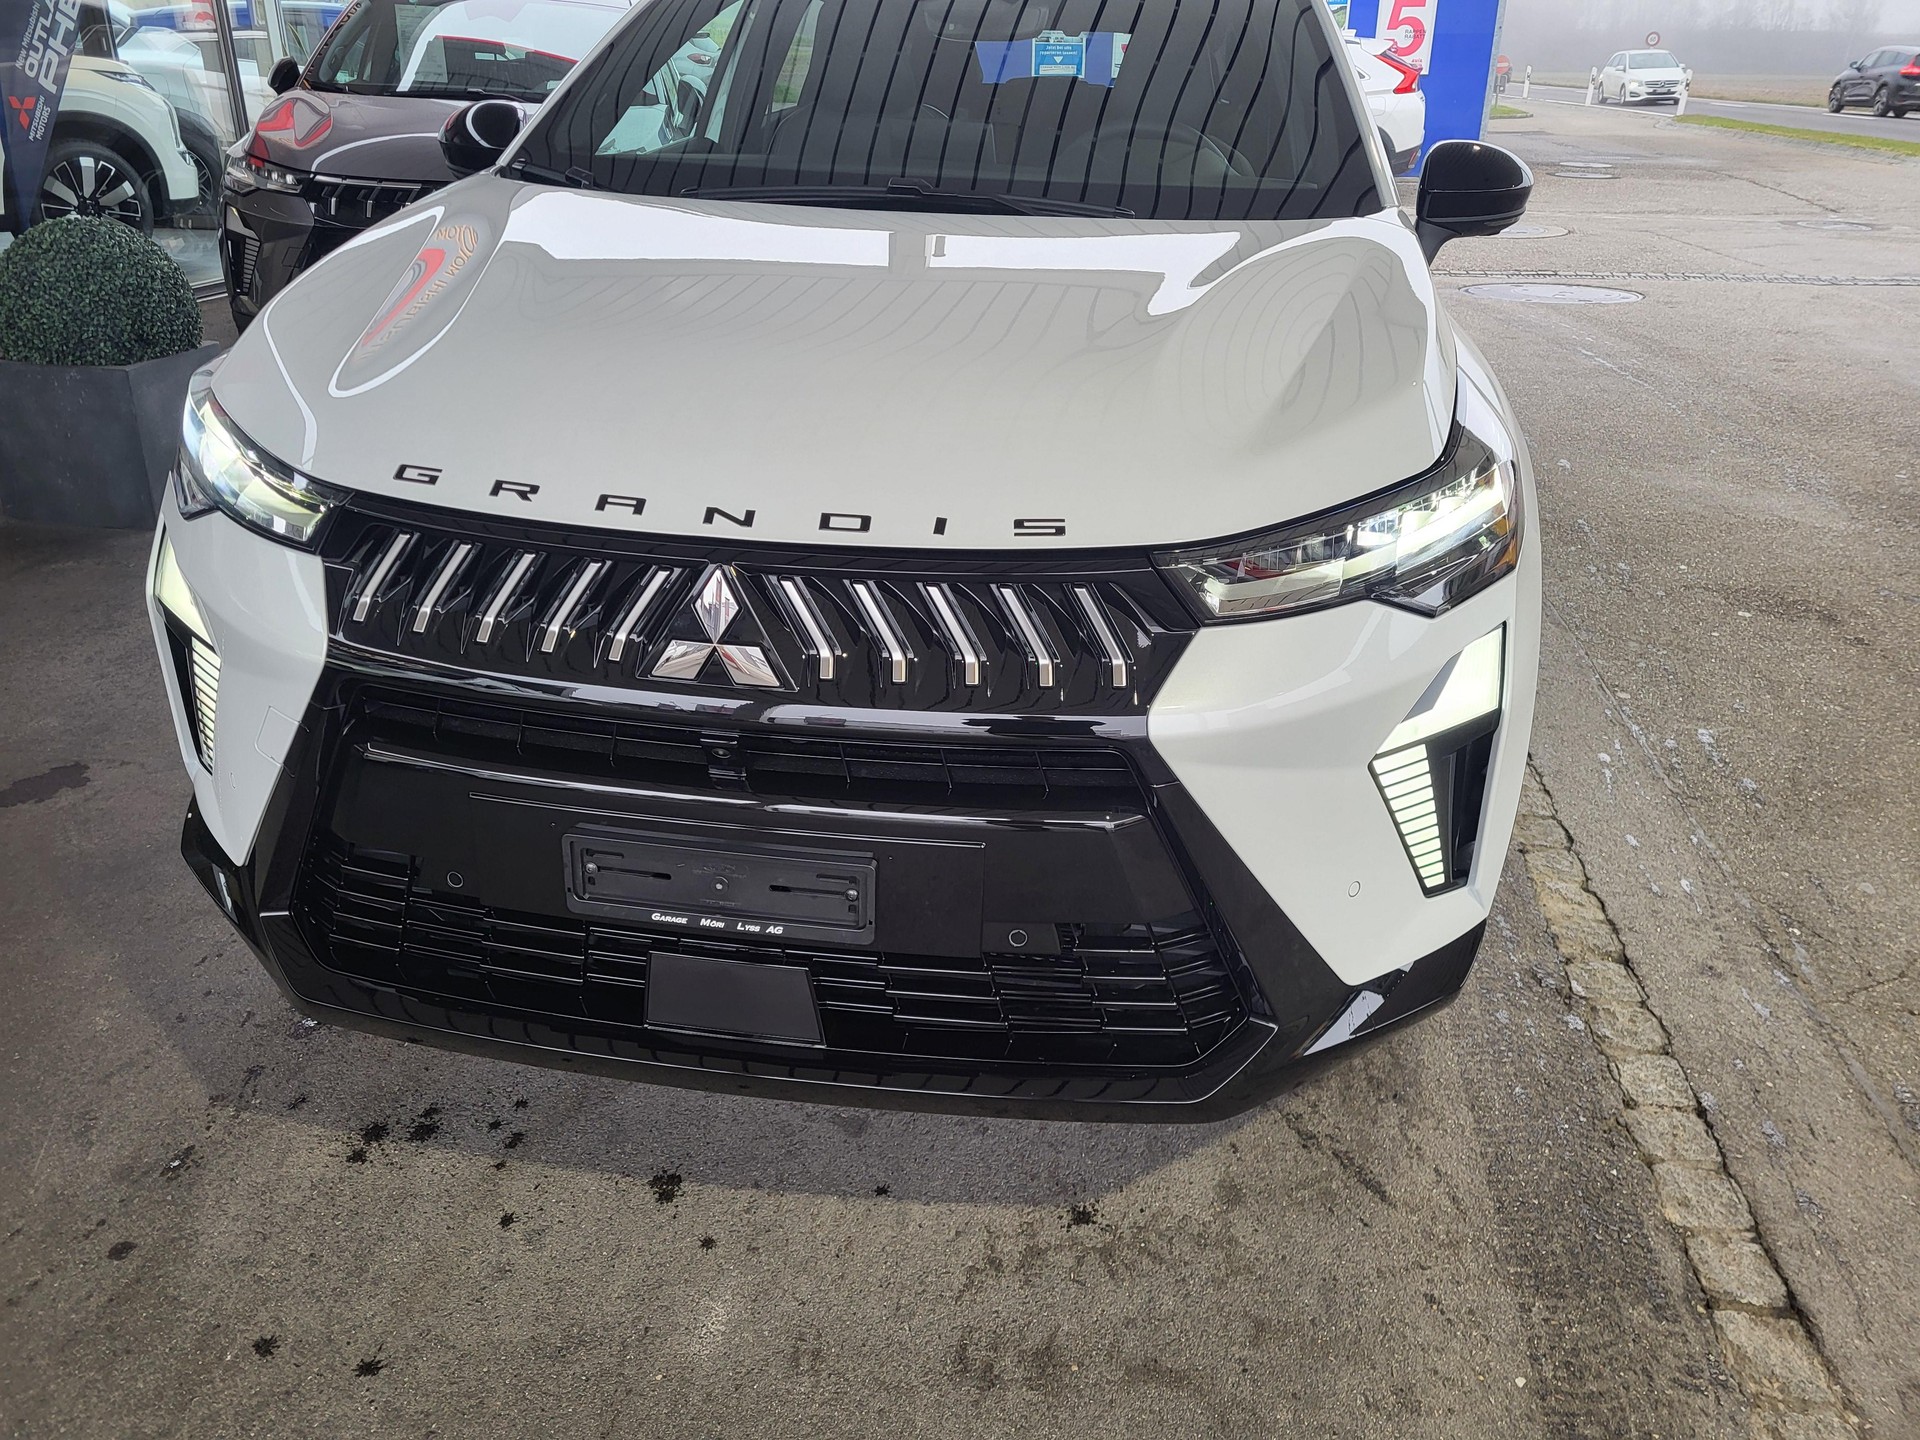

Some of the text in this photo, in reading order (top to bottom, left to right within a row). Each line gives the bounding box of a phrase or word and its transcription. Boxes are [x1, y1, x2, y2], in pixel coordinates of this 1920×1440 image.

[15, 1, 41, 70] New Mitsubishi
[1383, 0, 1426, 57] 5
[28, 95, 45, 142] MITSUBISHI
[35, 106, 51, 140] MOTORS
[393, 463, 1066, 537] GRANDIS
[766, 925, 784, 934] AG
